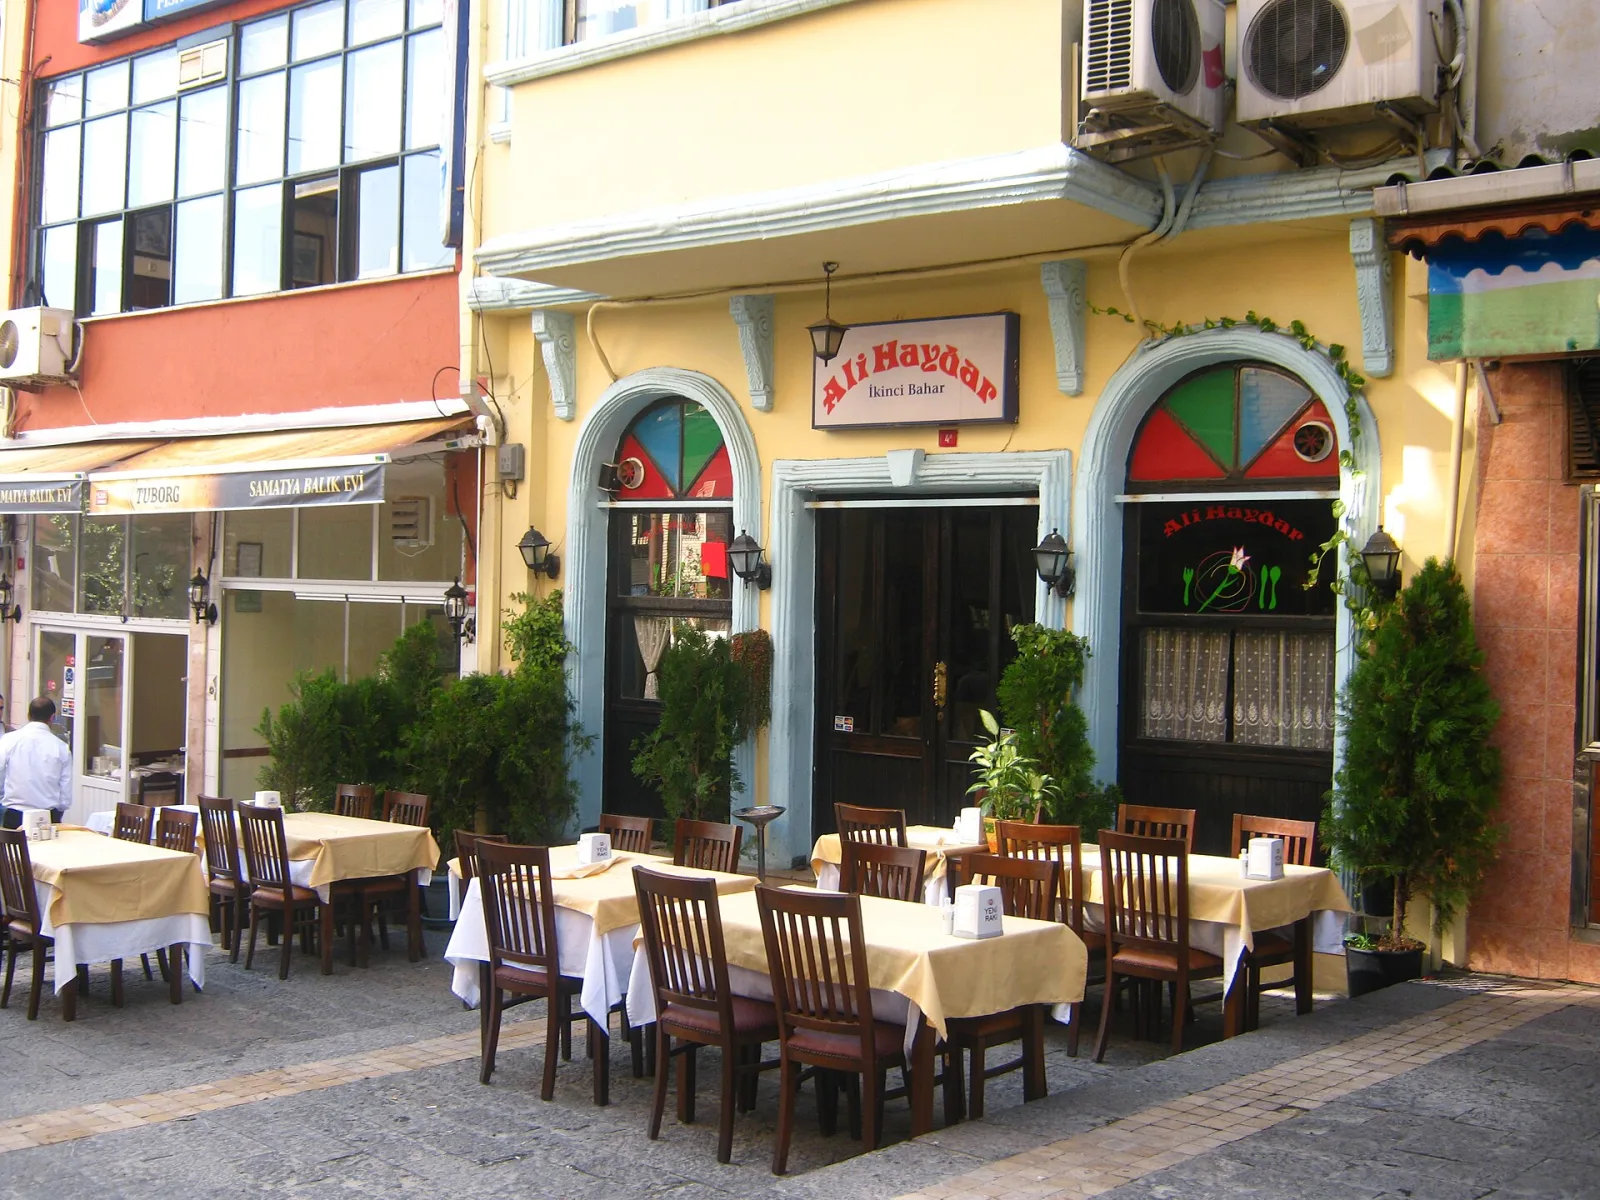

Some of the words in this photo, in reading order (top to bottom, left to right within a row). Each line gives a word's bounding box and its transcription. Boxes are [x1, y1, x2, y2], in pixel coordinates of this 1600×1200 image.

[823, 353, 869, 415] Ali
[872, 340, 997, 404] Haydar
[869, 384, 904, 398] İkinci
[908, 382, 945, 396] Bahar
[249, 478, 300, 497] SAMATYA
[304, 475, 341, 494] BALIK
[344, 470, 364, 492] EVİ
[0, 489, 27, 503] MATYA
[29, 488, 55, 503] BALIK
[136, 486, 180, 504] TUBORG
[1164, 508, 1201, 538] Ali
[1205, 504, 1304, 540] Haydar
